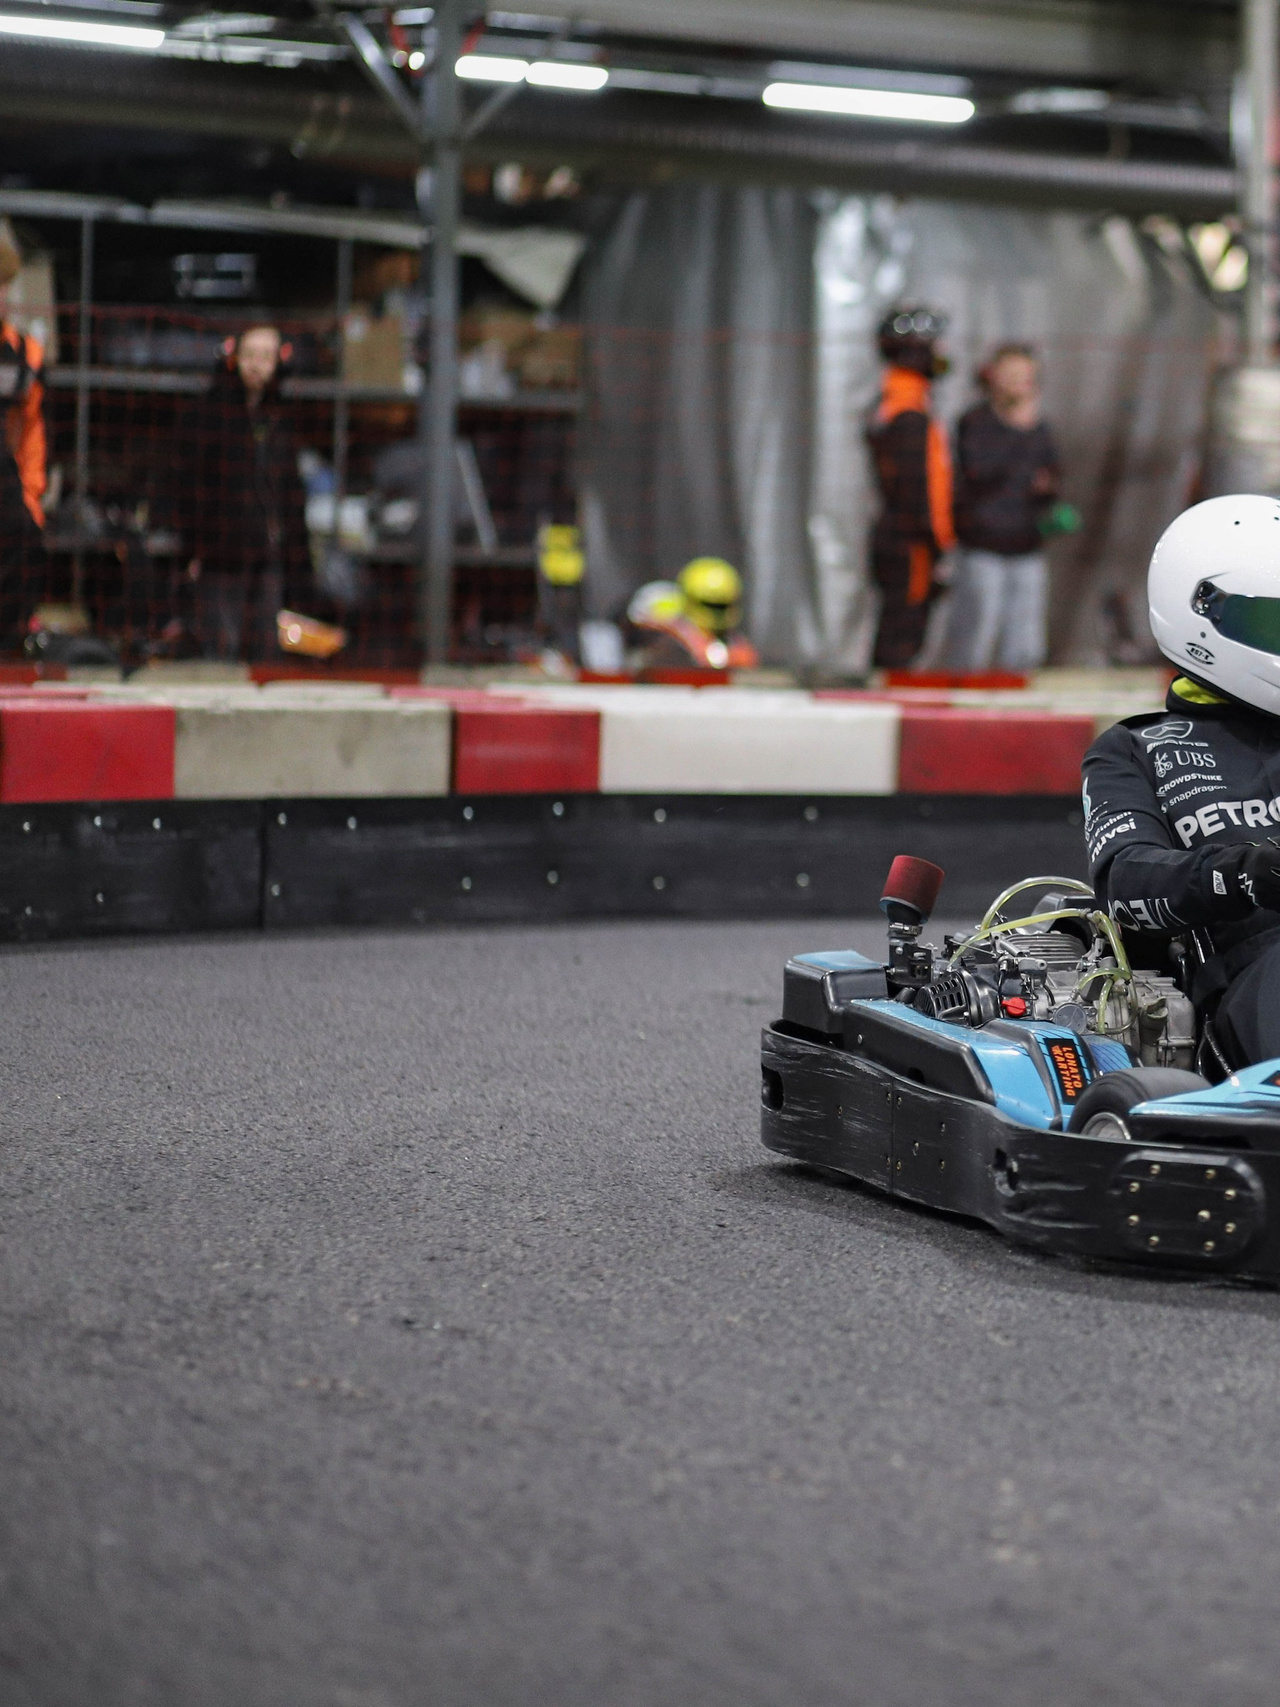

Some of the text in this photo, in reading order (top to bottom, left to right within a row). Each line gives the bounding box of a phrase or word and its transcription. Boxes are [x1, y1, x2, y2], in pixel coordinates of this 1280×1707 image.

[1173, 750, 1217, 768] UBS
[1157, 773, 1223, 795] CROWDSTRIKE
[1169, 785, 1227, 806] snapdragon
[1091, 817, 1137, 863] nuvei
[1053, 1046, 1076, 1097] KARTING
[1062, 1046, 1083, 1089] LONATO
